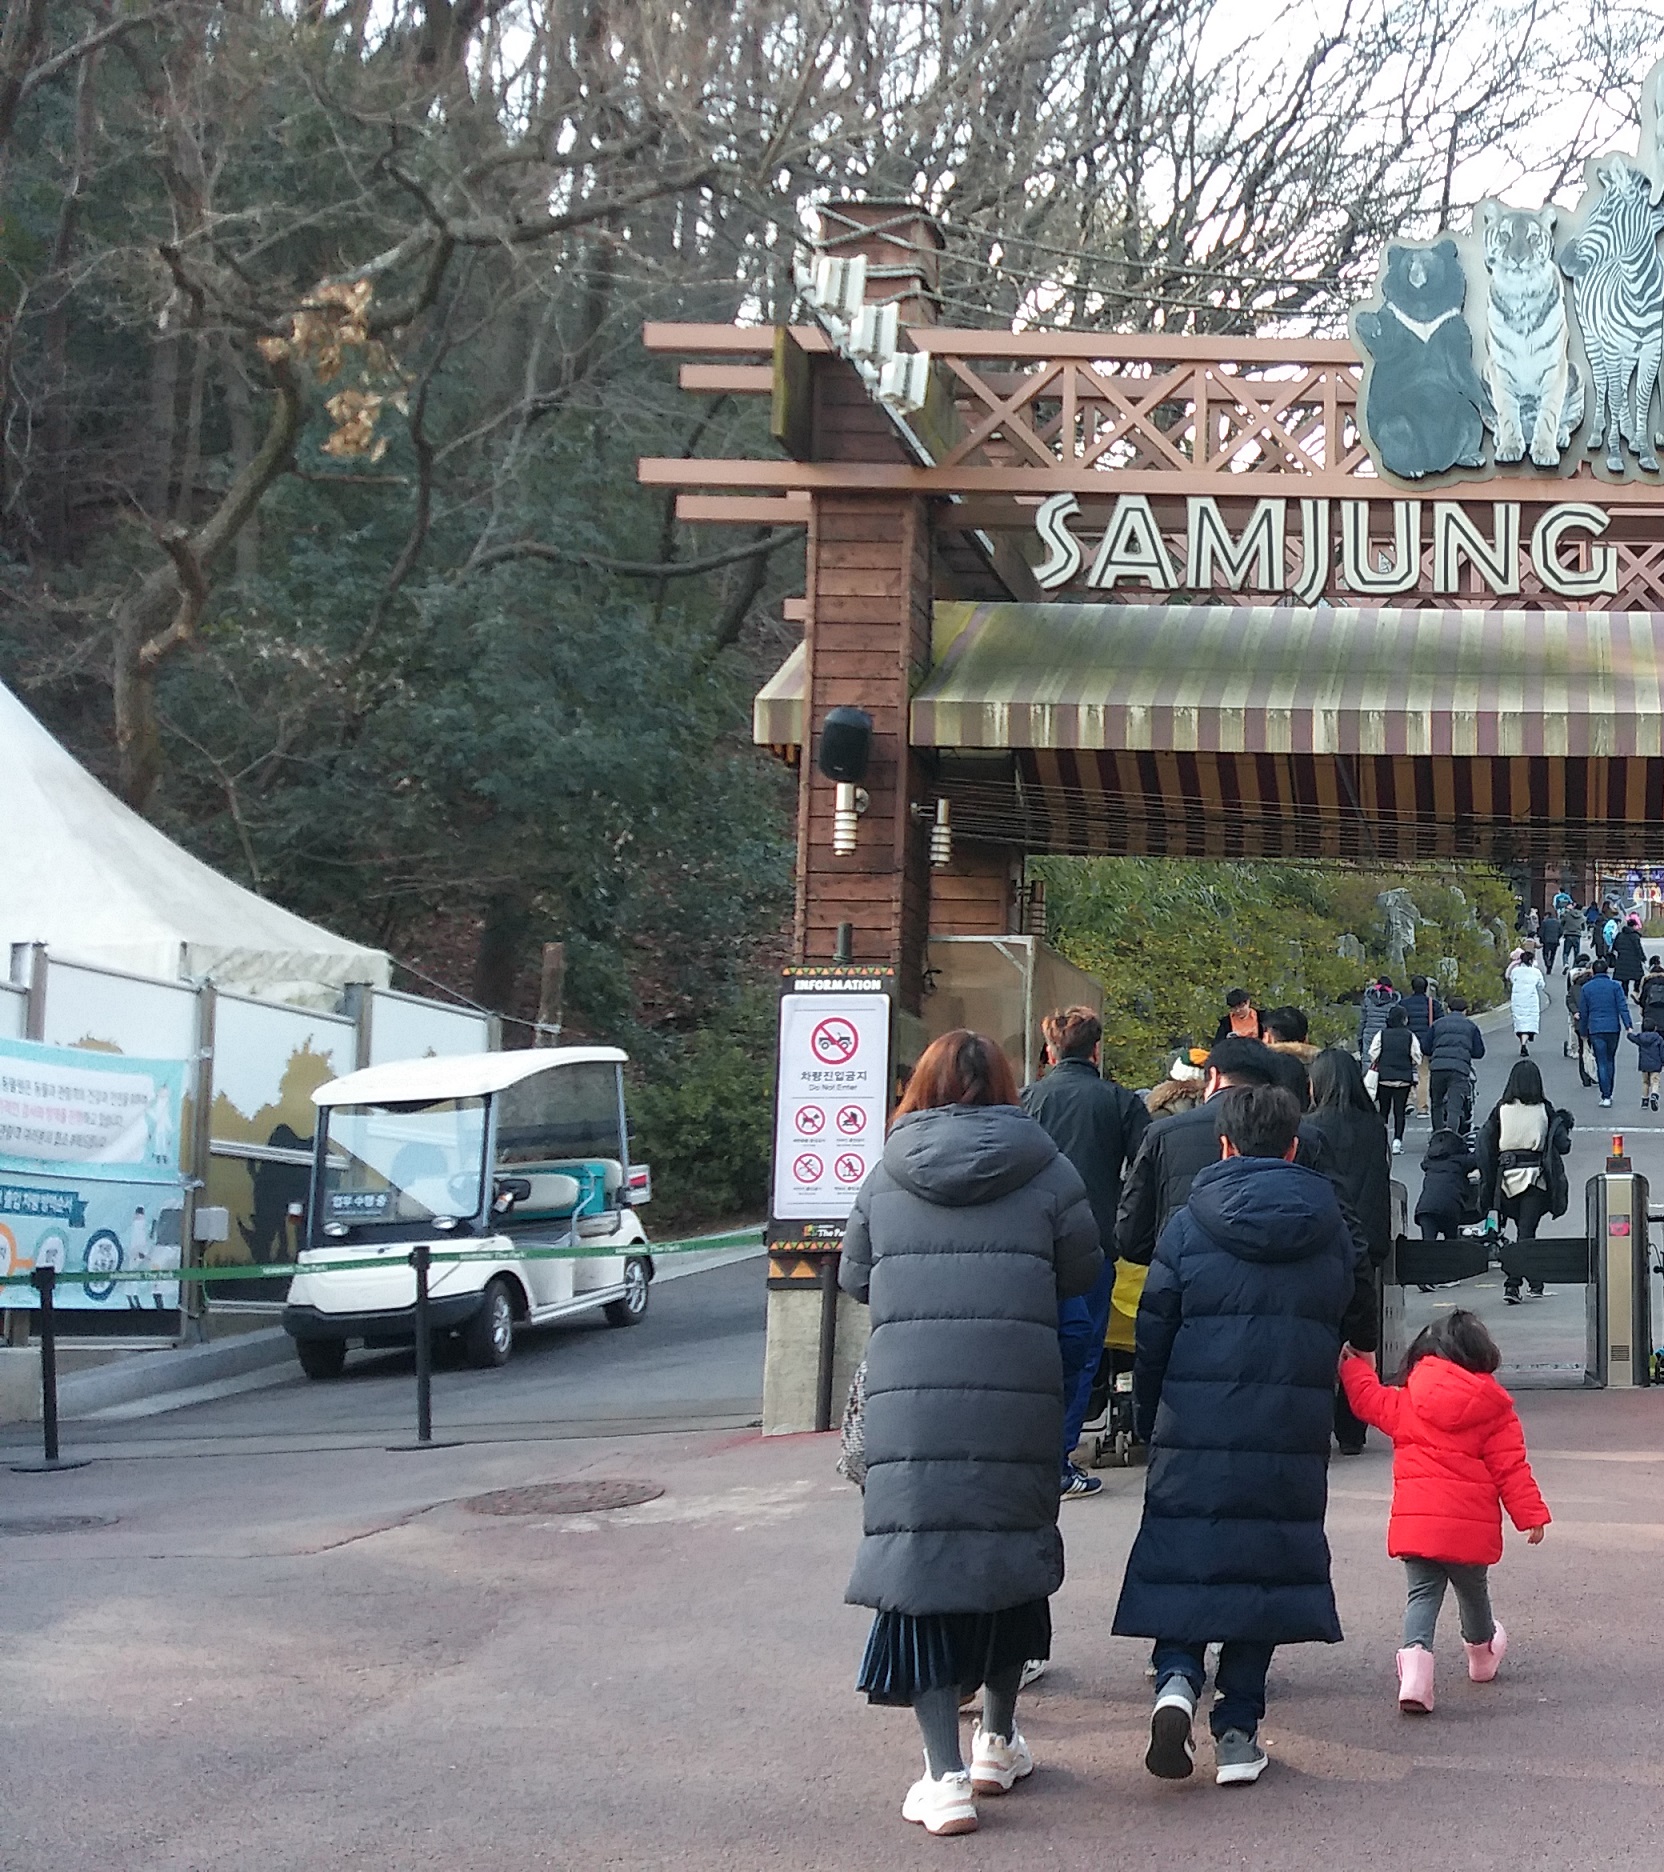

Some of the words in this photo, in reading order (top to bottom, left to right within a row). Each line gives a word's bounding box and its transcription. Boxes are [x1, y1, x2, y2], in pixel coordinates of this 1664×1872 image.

[1032, 491, 1620, 608] SAMJUNG
[794, 979, 881, 991] INFORMATION
[800, 1070, 868, 1082] 차량진입금지
[813, 1228, 833, 1237] The
